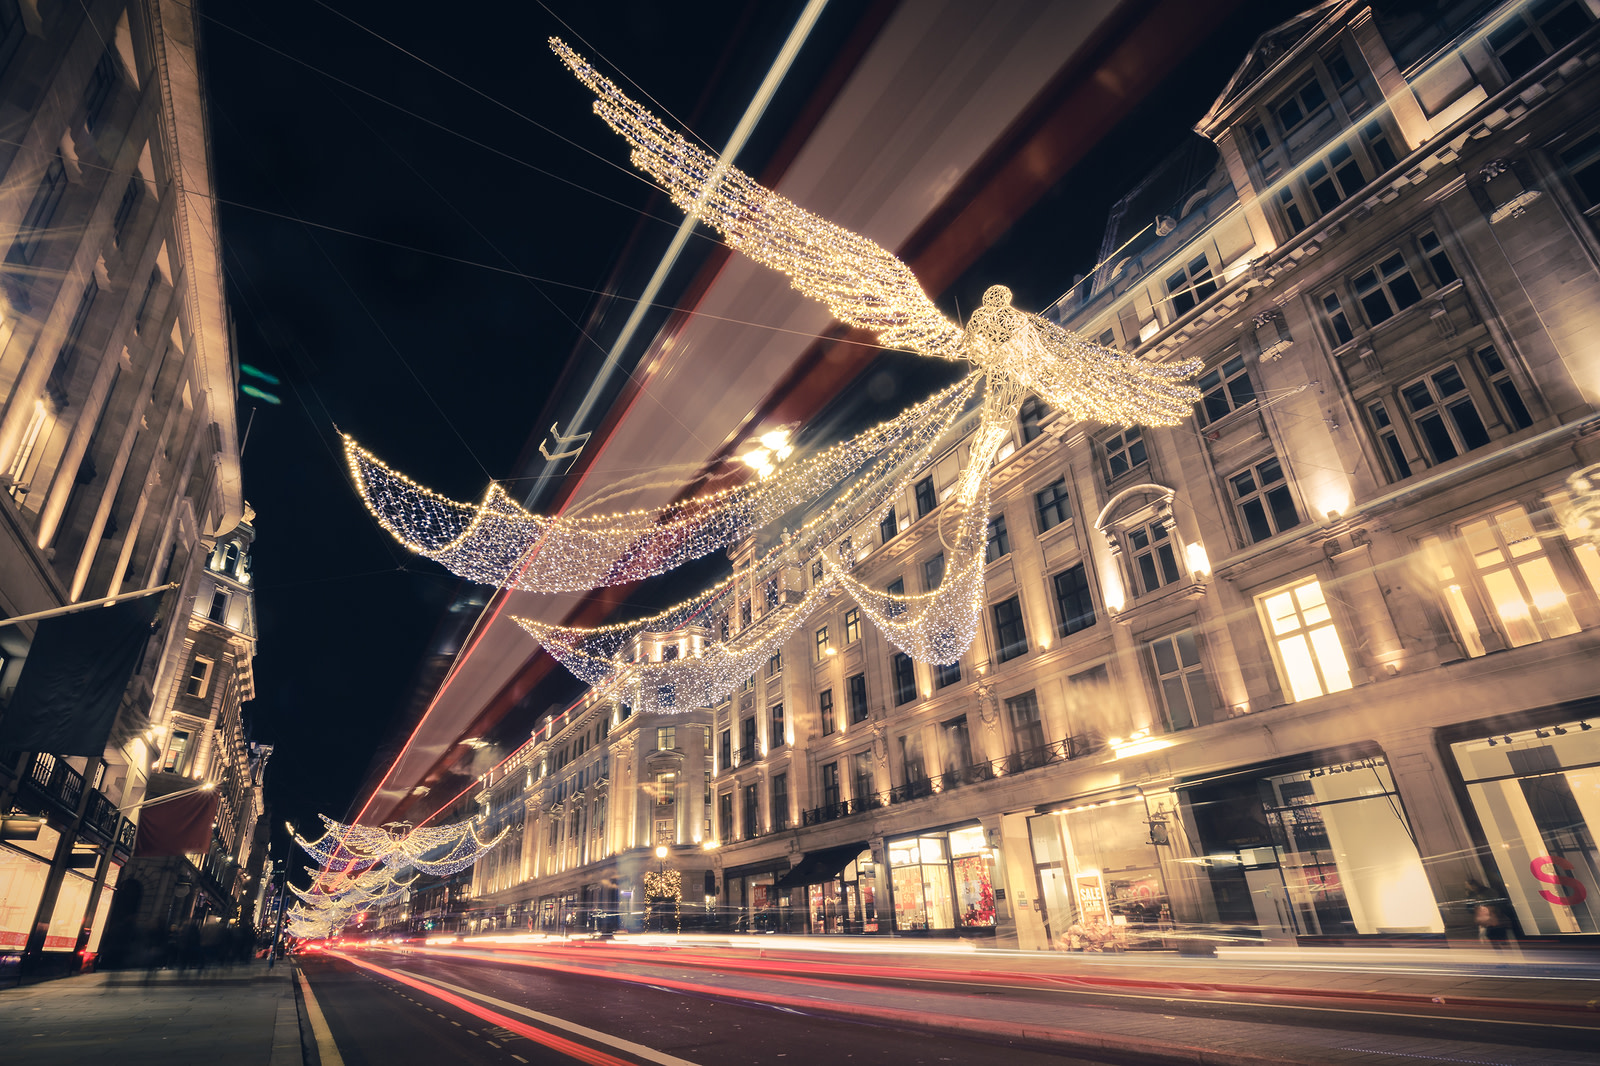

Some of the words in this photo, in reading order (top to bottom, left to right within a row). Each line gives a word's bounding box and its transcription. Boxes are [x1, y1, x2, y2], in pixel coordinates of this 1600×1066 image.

[1530, 855, 1587, 906] S
[755, 887, 767, 900] SALE
[1080, 887, 1102, 901] SALE
